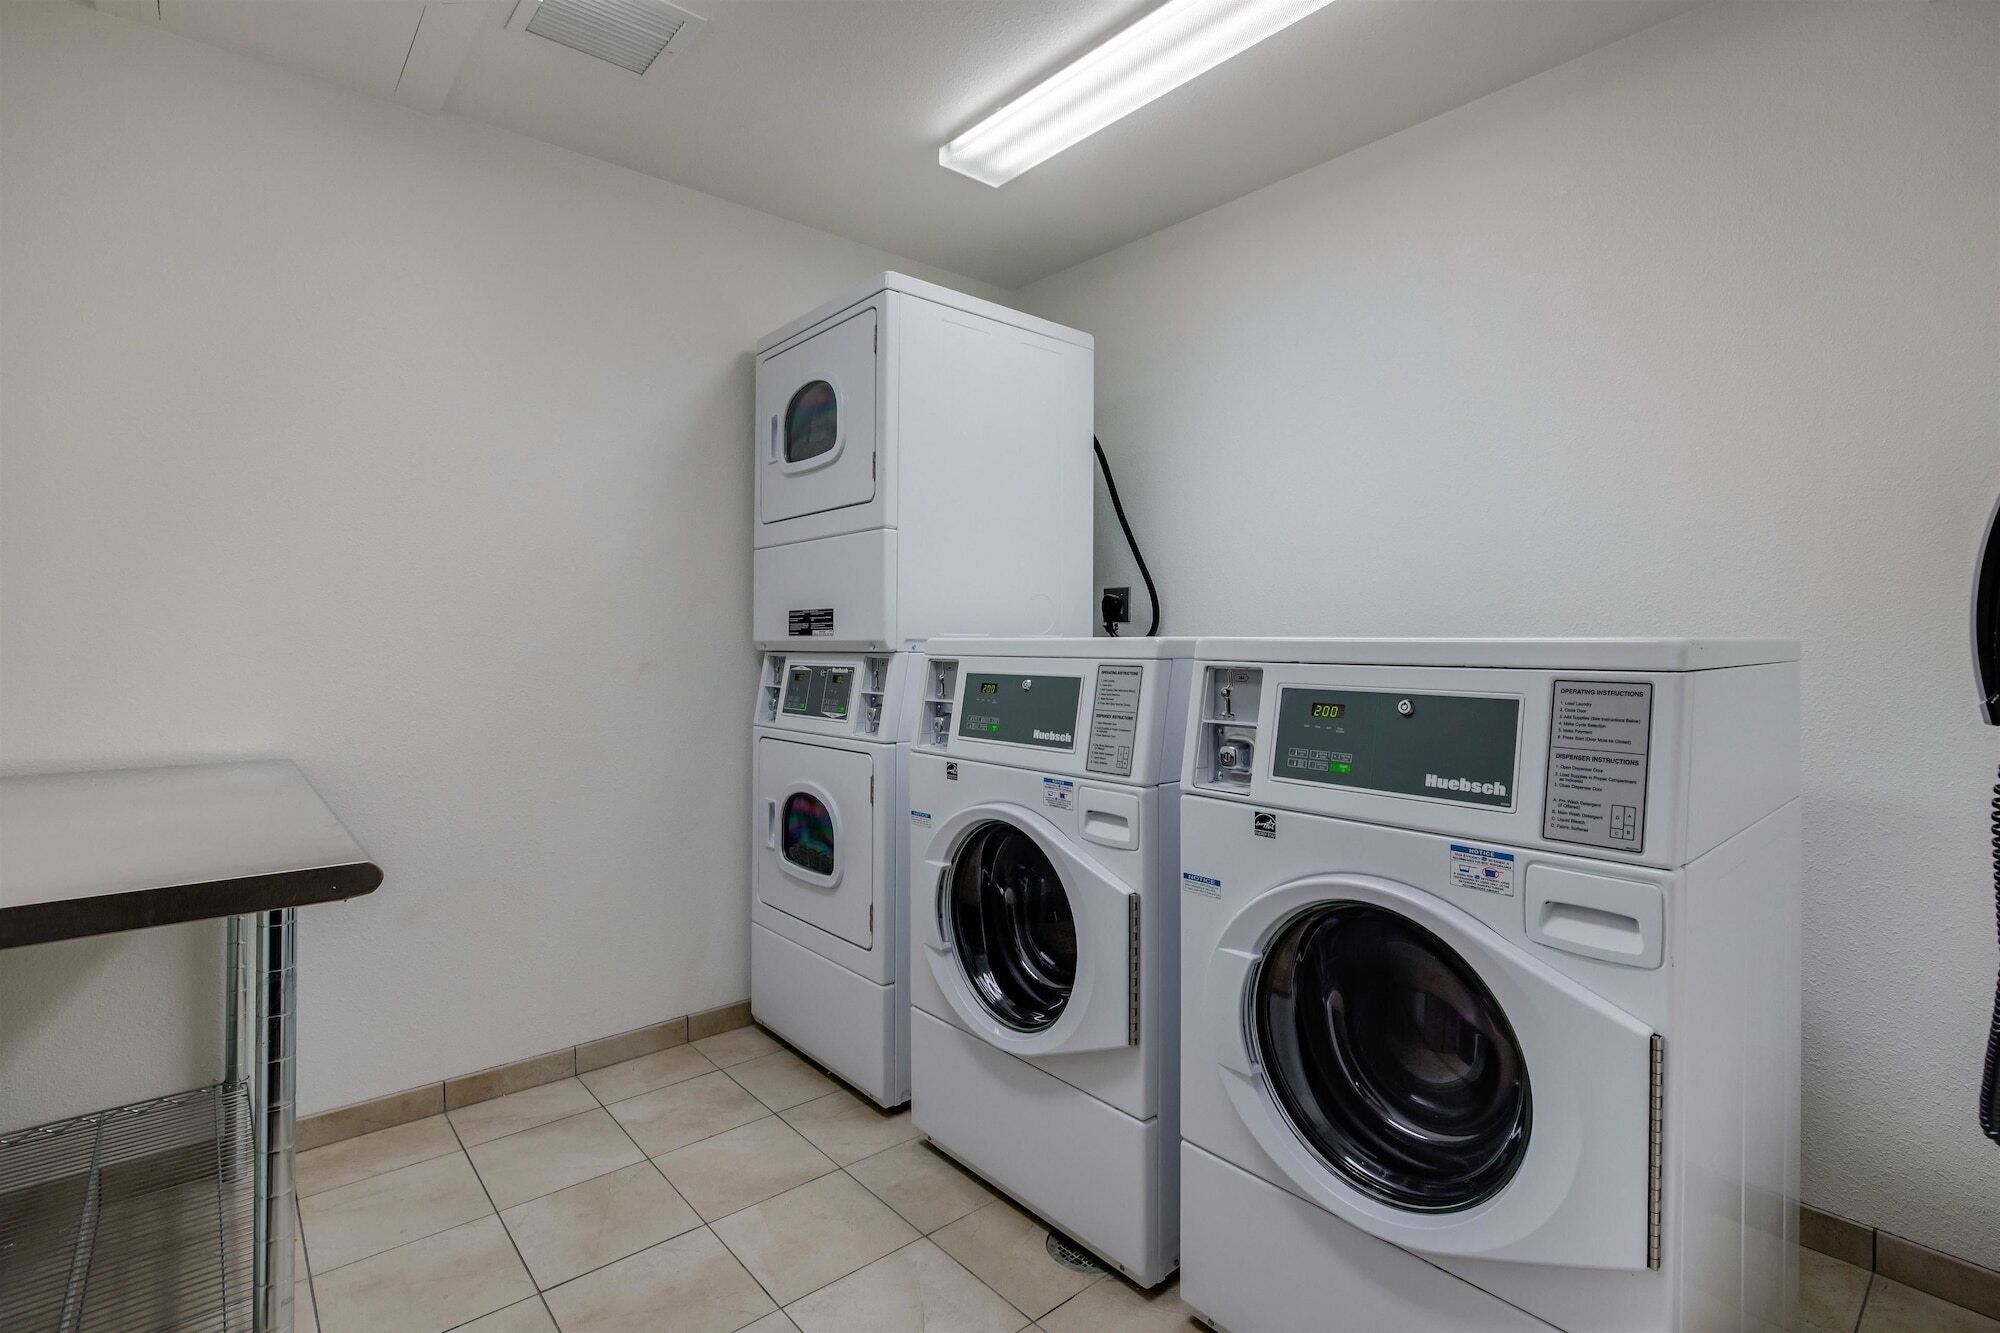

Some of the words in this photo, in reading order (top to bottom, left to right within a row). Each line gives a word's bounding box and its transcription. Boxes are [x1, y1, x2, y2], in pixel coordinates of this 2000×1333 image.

[982, 684, 995, 693] 200
[1314, 705, 1338, 717] 200
[1033, 729, 1072, 742] Huebsch
[1556, 753, 1590, 761] DISPENSER
[1592, 757, 1639, 766] INSTRUCTIONS
[1425, 774, 1506, 796] Huebsch
[1468, 848, 1494, 857] NOTICE
[1188, 874, 1215, 884] NOTICE
